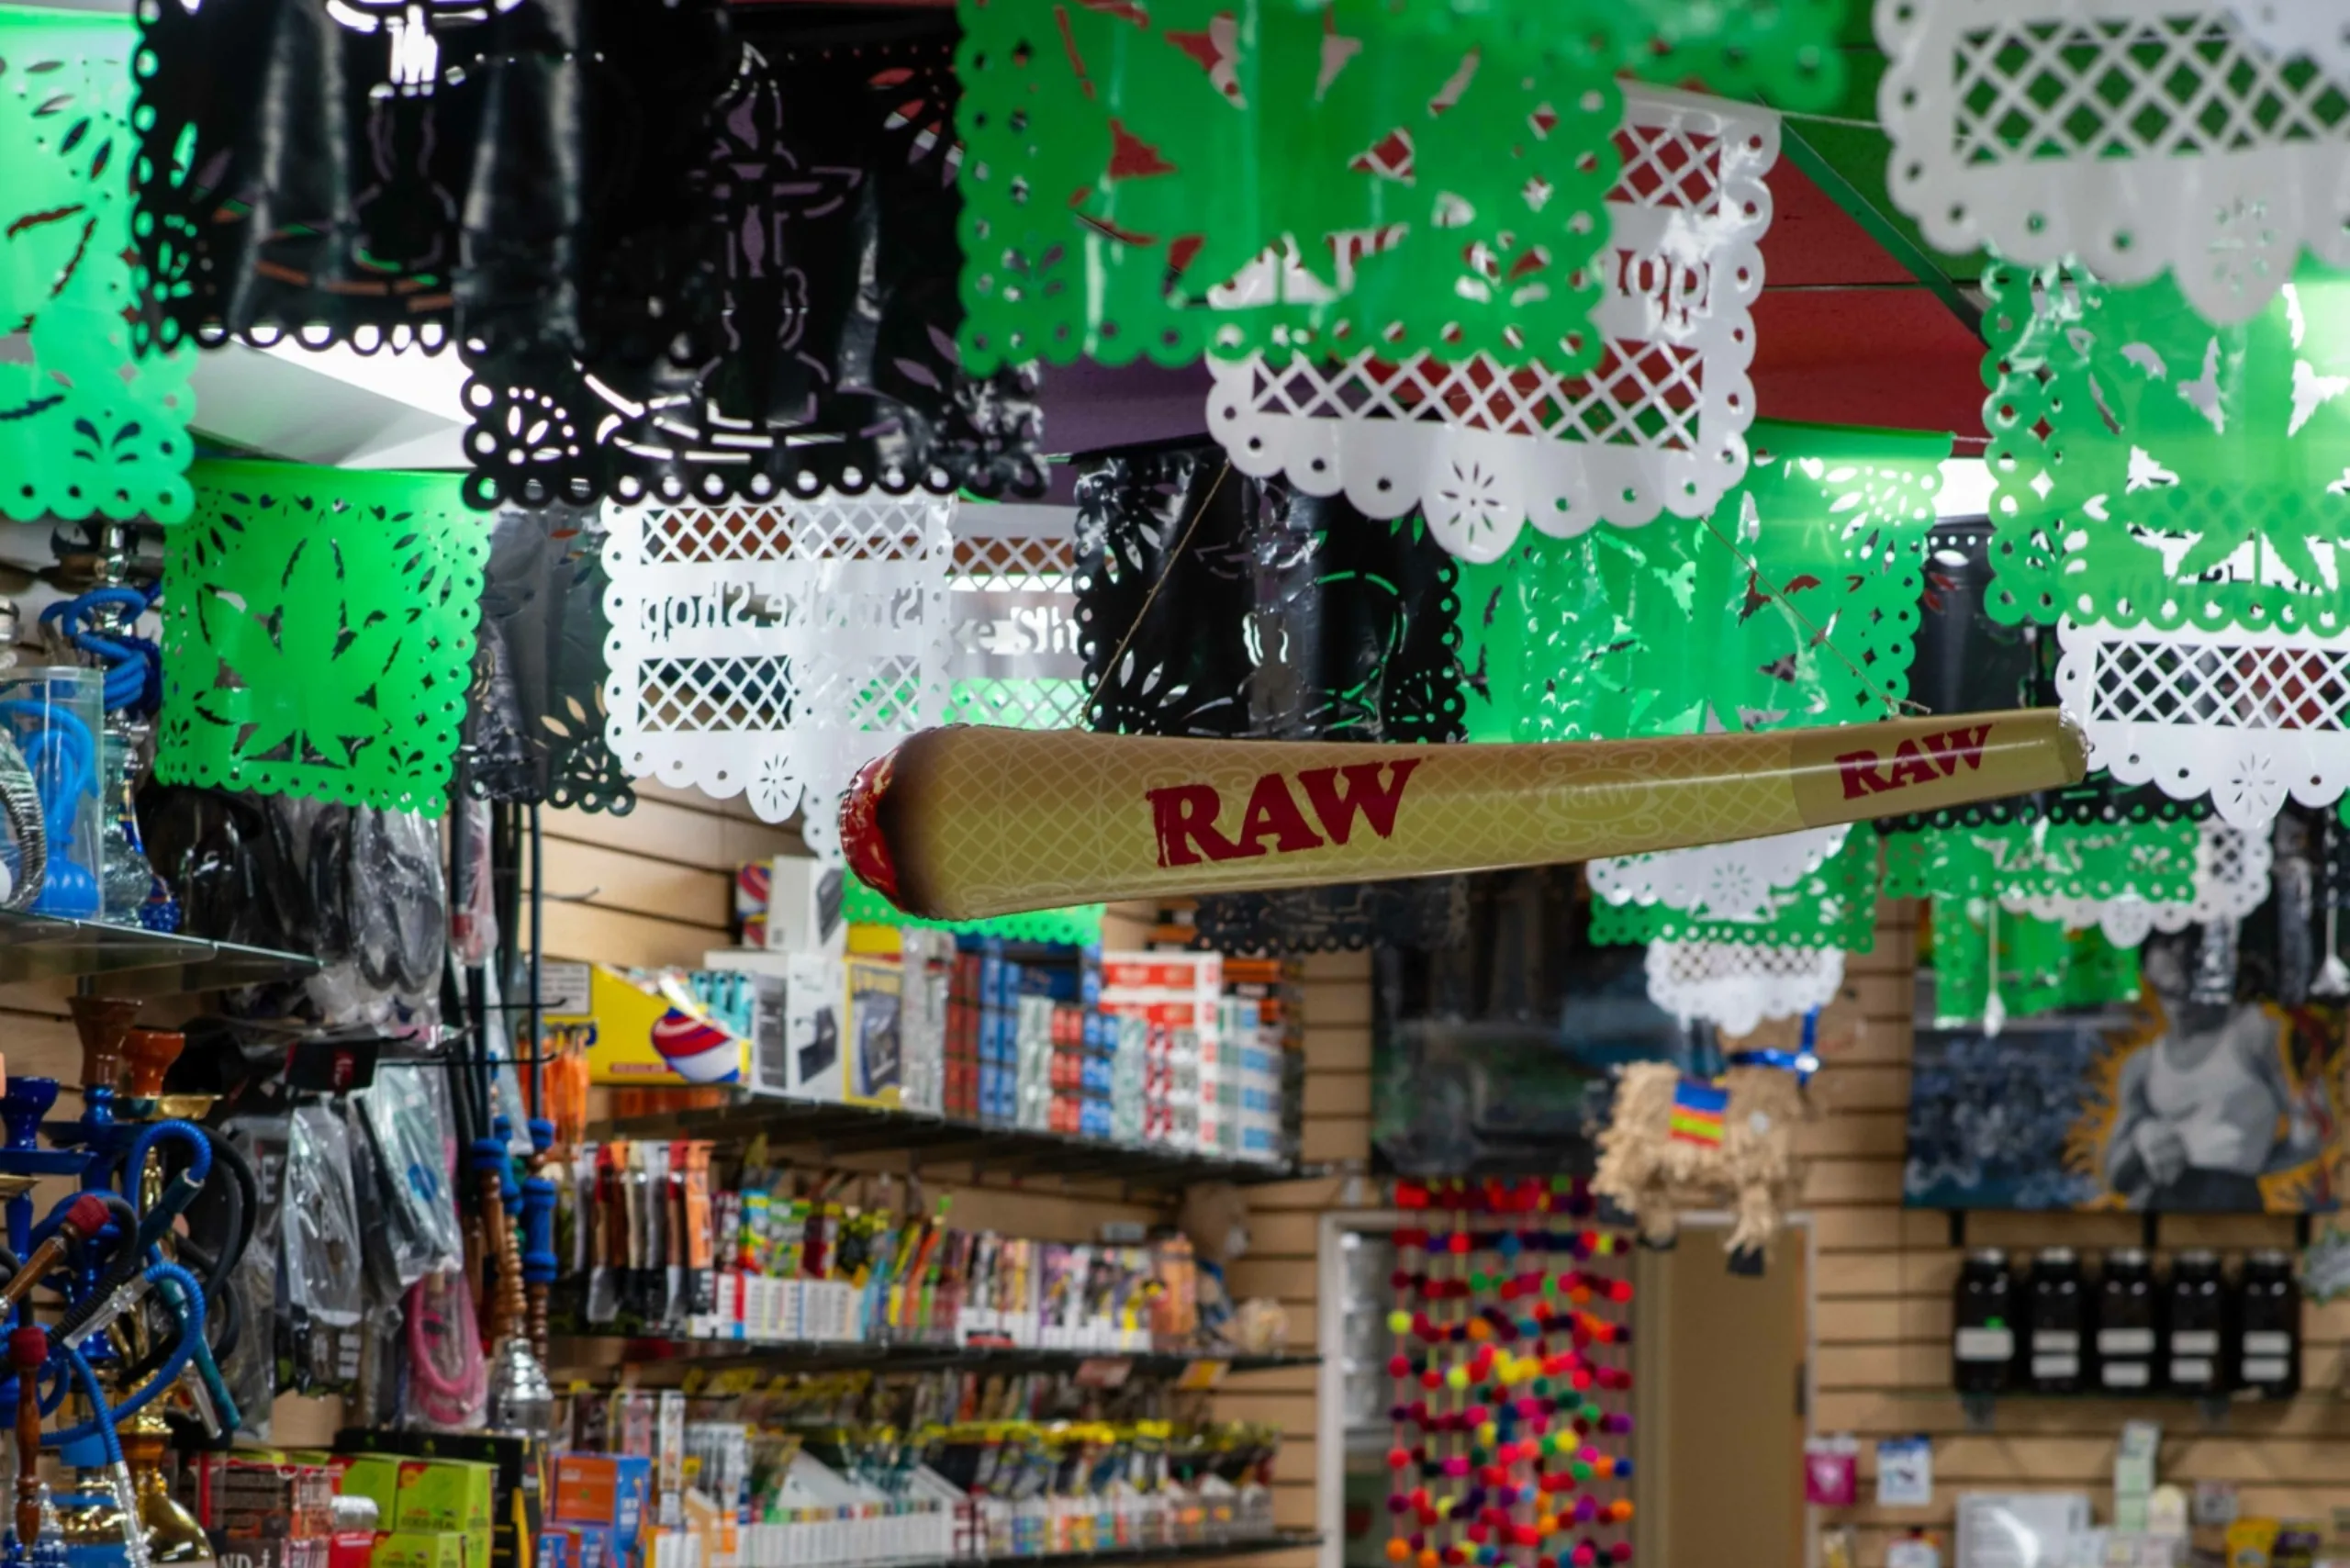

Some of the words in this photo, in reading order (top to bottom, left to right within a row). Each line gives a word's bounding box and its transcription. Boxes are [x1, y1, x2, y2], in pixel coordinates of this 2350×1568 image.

[1011, 606, 1079, 655] Sh
[1834, 722, 1993, 801] RAW
[1145, 756, 1421, 868] RAW
